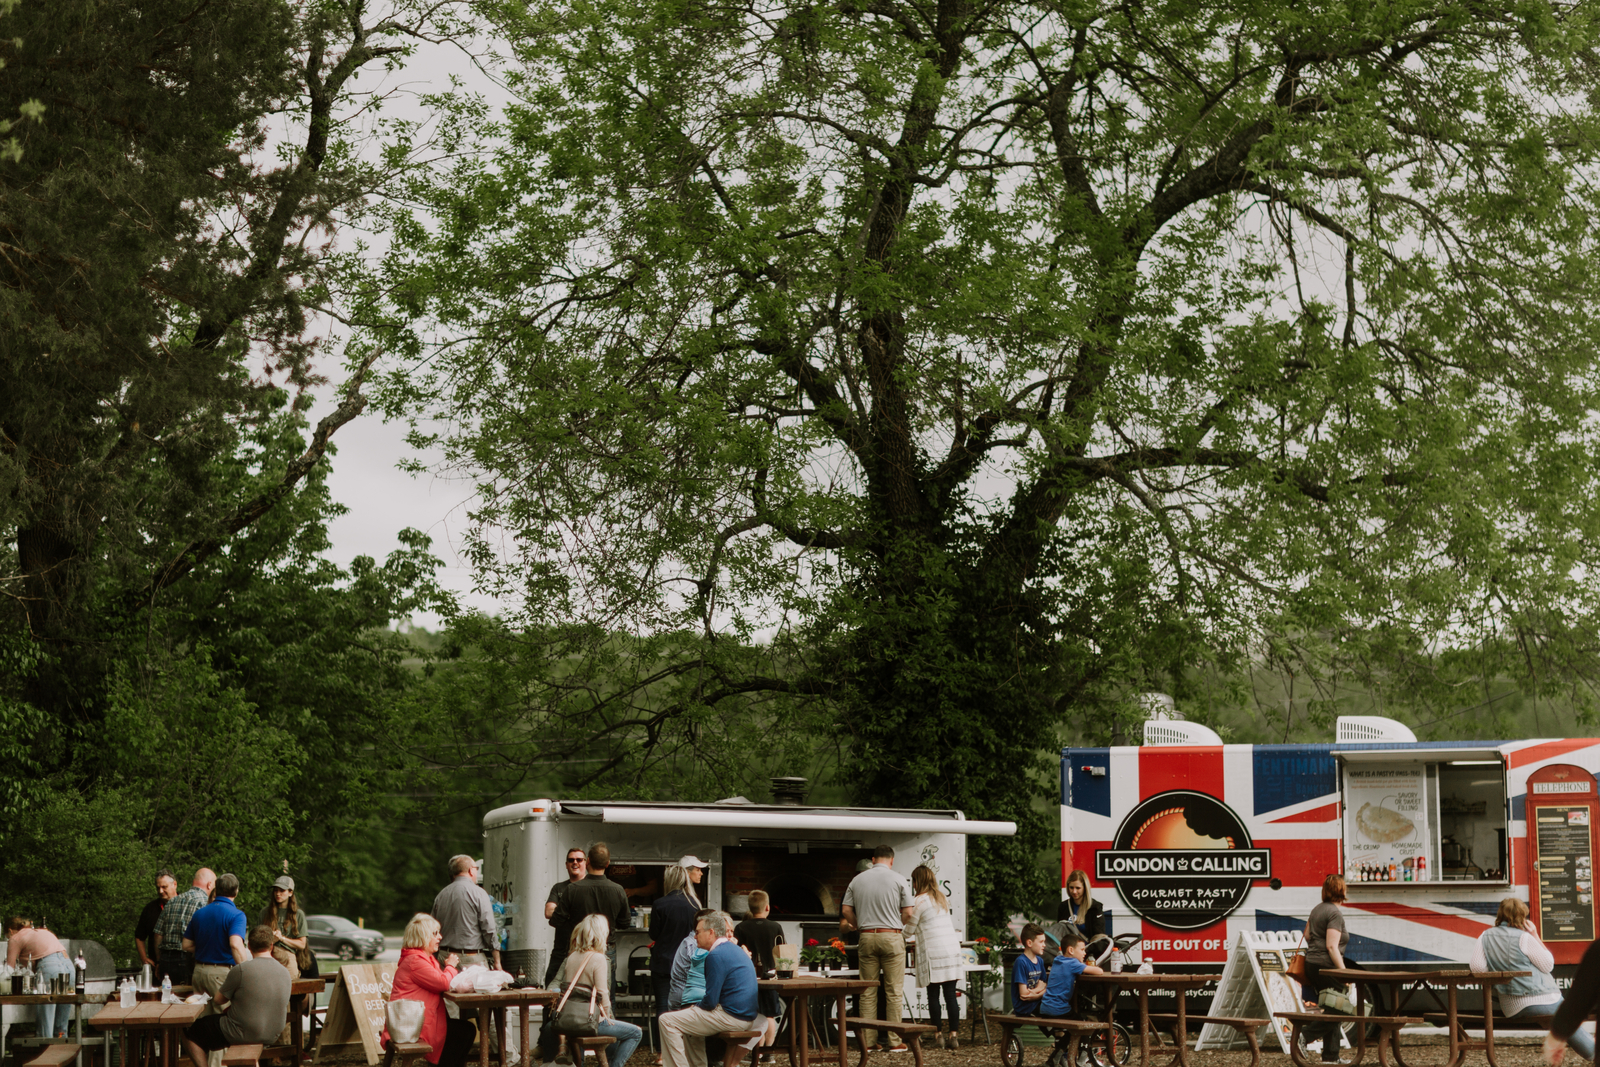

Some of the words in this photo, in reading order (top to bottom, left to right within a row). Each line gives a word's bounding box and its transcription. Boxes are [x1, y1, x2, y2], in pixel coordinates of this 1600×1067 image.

[1534, 782, 1589, 792] TELEPHONE
[1104, 858, 1175, 872] LONDON
[1191, 857, 1262, 872] CALLING
[1132, 889, 1193, 899] GOURMET
[1197, 888, 1237, 899] PASTY
[1155, 899, 1214, 909] COMPANY
[1143, 940, 1171, 950] BITE
[1173, 940, 1201, 950] OUT
[1203, 940, 1220, 950] OF
[369, 1016, 386, 1026] WIN
